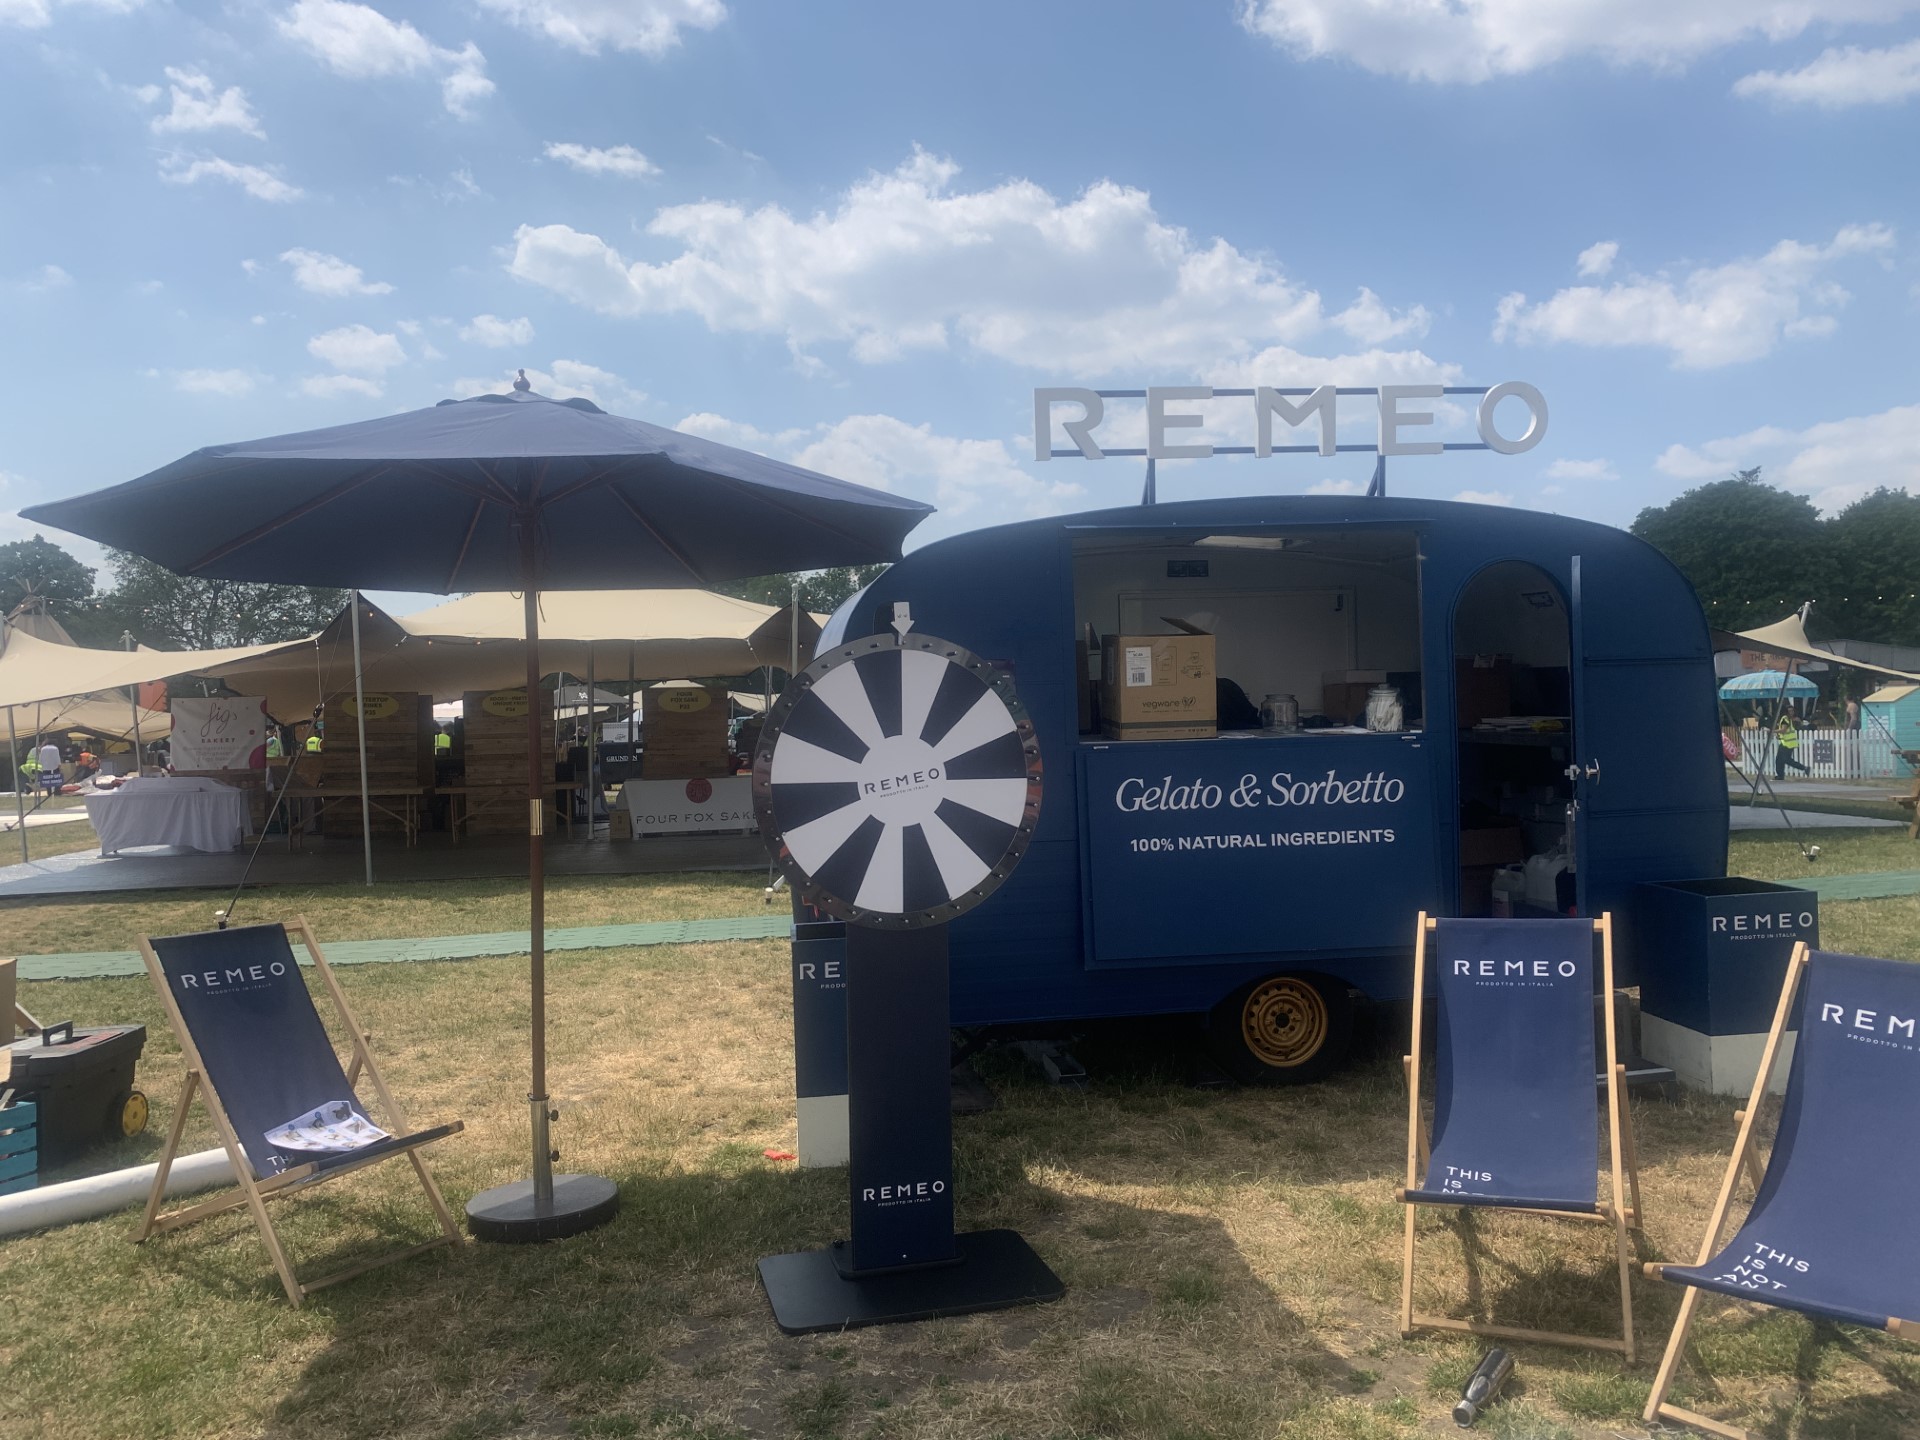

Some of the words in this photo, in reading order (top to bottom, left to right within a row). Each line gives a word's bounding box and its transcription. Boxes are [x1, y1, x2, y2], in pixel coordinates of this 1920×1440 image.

[1034, 380, 1549, 461] REMEO
[1142, 700, 1180, 709] vegware
[864, 768, 939, 794] REMEO
[1116, 775, 1222, 812] Gelato
[1229, 773, 1261, 808] &
[1267, 769, 1405, 807] Sorbetto
[636, 814, 678, 824] FOUR
[685, 812, 714, 822] FOX
[1130, 838, 1174, 852] 100%
[1179, 833, 1267, 850] NATURAL
[1271, 828, 1395, 847] INGREDIENTS
[1712, 911, 1813, 932] REMEO
[181, 962, 285, 989] REMEO
[1454, 960, 1576, 977] REMEO
[1847, 1033, 1898, 1048] PRODOTTO
[1444, 1178, 1462, 1189] IS
[1446, 1165, 1492, 1181] THIS
[863, 1180, 945, 1201] REMEO
[1743, 1255, 1767, 1270] IS
[1755, 1242, 1810, 1272] THIS
[1733, 1265, 1787, 1290] NOT
